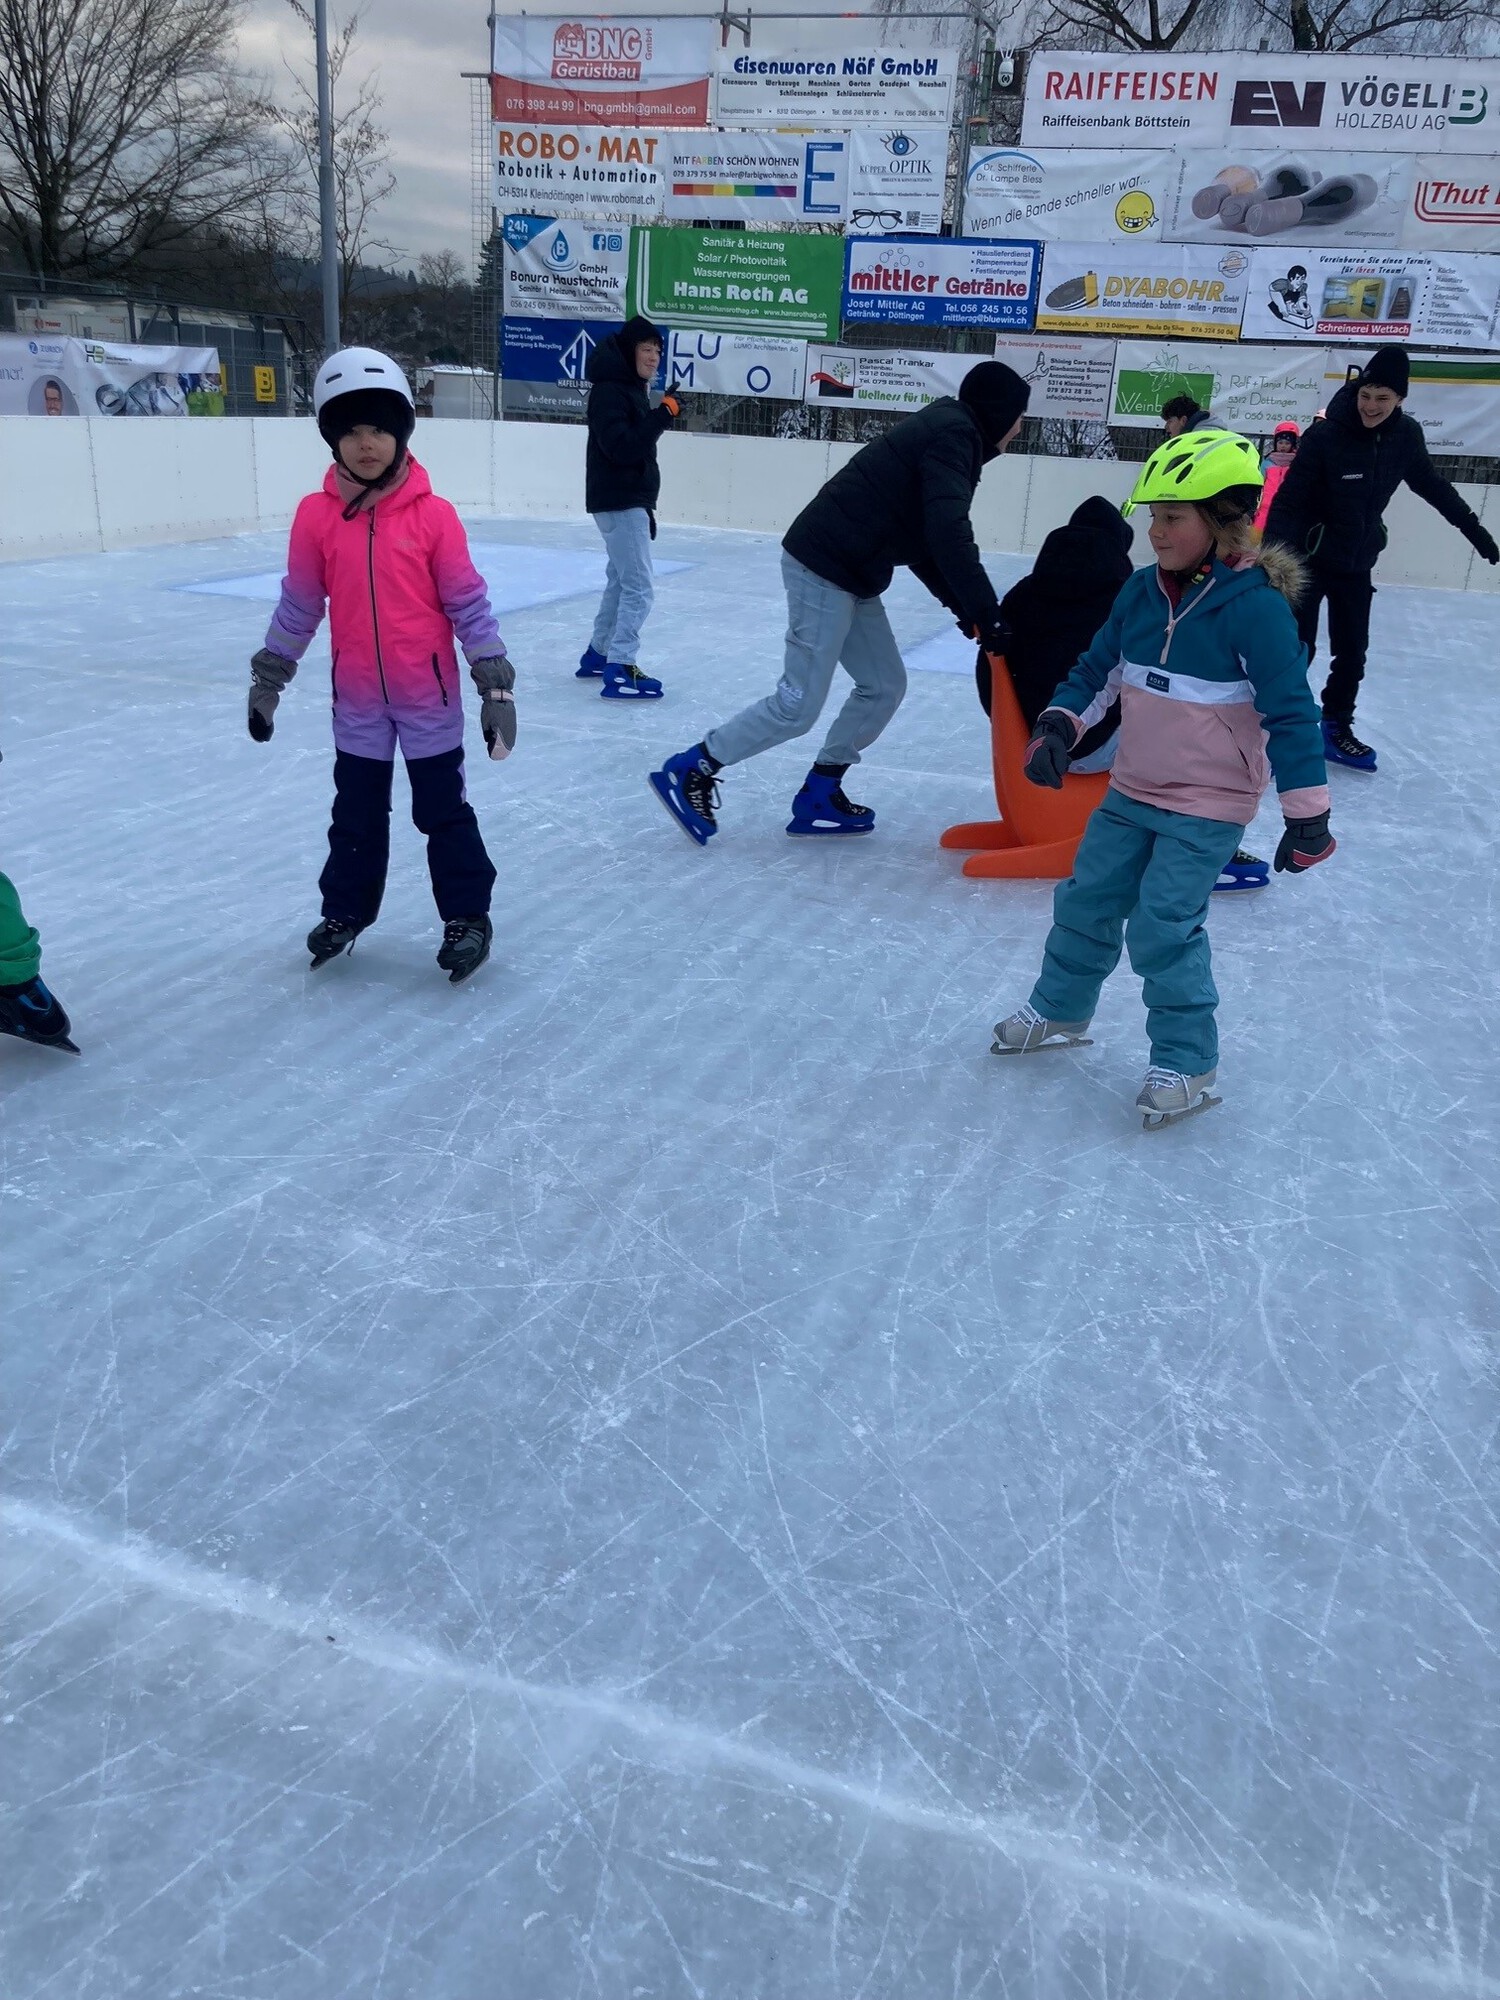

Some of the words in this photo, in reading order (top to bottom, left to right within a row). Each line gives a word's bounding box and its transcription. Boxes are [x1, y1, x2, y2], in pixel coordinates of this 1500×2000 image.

[584, 28, 642, 59] BNG
[644, 28, 652, 60] GmbH
[556, 62, 636, 79] Gerüstbau
[734, 56, 836, 76] Eisenwaren
[842, 56, 874, 76] Näf
[881, 58, 938, 76] GmbH
[722, 78, 758, 86] Eisenwaren
[765, 80, 800, 88] Werkzeuge
[880, 80, 910, 88] Gasdepot
[1045, 72, 1218, 100] RAIFFEISEN
[780, 90, 828, 98] Schliessanlagen
[1341, 76, 1450, 108] VÖGELI
[506, 99, 526, 110] 076
[527, 100, 544, 110] 398
[547, 100, 560, 110] 44
[562, 100, 574, 111] 99
[584, 102, 696, 115] bng.gmbh@gmail.com
[1230, 81, 1326, 127] EV
[1042, 115, 1130, 127] Raiffeisenbank
[1135, 116, 1190, 128] Böttstein
[1336, 113, 1417, 130] HOLZBAU
[1422, 115, 1446, 130] AG
[673, 156, 690, 165] MIT
[692, 156, 724, 166] FARBEN
[726, 154, 756, 166] SCHÖN
[758, 157, 799, 166] WOHNEN
[498, 162, 553, 179] Robotik
[573, 166, 656, 184] Automation
[890, 160, 932, 174] OPTIK
[984, 163, 996, 172] Dr.
[998, 163, 1038, 173] Schifferle
[720, 171, 798, 180] maler@farbigwohnen.ch
[976, 174, 988, 182] Dr.
[990, 174, 1020, 184] Lampe
[1022, 175, 1042, 184] Bless
[498, 186, 528, 198] CH-5314
[530, 187, 584, 204] Kleindöttingen
[590, 193, 656, 206] www.robomat.ch
[1430, 182, 1490, 205] Thut
[970, 216, 1002, 232] Wenn
[1005, 208, 1022, 224] die
[1026, 200, 1061, 218] Bande
[1064, 182, 1116, 206] schneller
[1118, 174, 1150, 192] war...
[508, 220, 528, 233] 24h
[702, 237, 735, 248] Sanitär
[738, 239, 744, 248] &
[747, 240, 784, 252] Heizung
[698, 252, 722, 263] Solar
[730, 255, 787, 266] Photovoltaik
[977, 250, 1031, 258] Hauslieferdienst
[1320, 256, 1365, 264] Vereinbaren
[1368, 256, 1380, 264] Sie
[976, 258, 1028, 266] Rampenverkauf
[580, 264, 608, 274] GmbH
[694, 266, 790, 283] Wasserversorgungen
[976, 267, 1026, 276] Festlieferungen
[1340, 266, 1353, 274] für
[1378, 266, 1406, 275] Traum!
[510, 270, 548, 284] Bonura
[554, 274, 619, 288] Haustechnik
[851, 264, 940, 293] mittler
[946, 276, 1027, 297] Getränke
[550, 288, 576, 297] Heizung
[674, 282, 721, 298] Hans
[726, 284, 773, 302] Roth
[780, 288, 808, 304] AG
[1104, 276, 1225, 302] DYABOHR
[562, 304, 620, 313] www.bonura-ht.ch
[698, 304, 759, 316] info@hansrothag.ch
[764, 310, 827, 320] www.hansrothag.ch
[848, 299, 874, 308] Josef
[878, 300, 908, 310] Mittler
[912, 302, 925, 310] AG
[945, 304, 958, 312] Tel.
[960, 304, 977, 312] 056
[982, 305, 998, 313] 245
[1003, 306, 1012, 314] 10
[1016, 306, 1028, 314] 56
[1102, 298, 1120, 308] Beton
[1122, 300, 1154, 308] schneiden
[1160, 301, 1182, 310] bohren
[1188, 302, 1206, 312] seilen
[1212, 304, 1238, 314] pressen
[847, 310, 880, 318] Getränke
[888, 311, 924, 321] Döttingen
[943, 314, 1027, 324] mittlerag@bluewin.ch
[505, 324, 532, 333] Transporte
[1043, 320, 1090, 328] www.dyabohr.ch
[1317, 323, 1368, 334] Schreinerei
[1372, 324, 1410, 334] Wettach
[524, 334, 544, 342] Logistik
[505, 340, 533, 349] Entsorgung
[538, 342, 562, 351] Recycling
[754, 344, 788, 352] Architekten
[1040, 342, 1082, 350] Autowerkstatt
[898, 358, 935, 368] Trankar
[1050, 358, 1072, 366] Shining
[880, 371, 910, 379] Döttingen
[1064, 381, 1106, 389] Kleindöttingen
[1230, 376, 1251, 388] Rolf
[1260, 376, 1281, 390] Tanja
[1284, 378, 1318, 390] Knecht
[528, 395, 556, 405] Andere
[558, 398, 582, 406] reden
[858, 390, 901, 401] Wellness
[904, 392, 918, 402] für
[1046, 394, 1104, 402] info@shiningcars.ch
[1228, 396, 1246, 404] 5312
[1250, 392, 1297, 408] Döttingen
